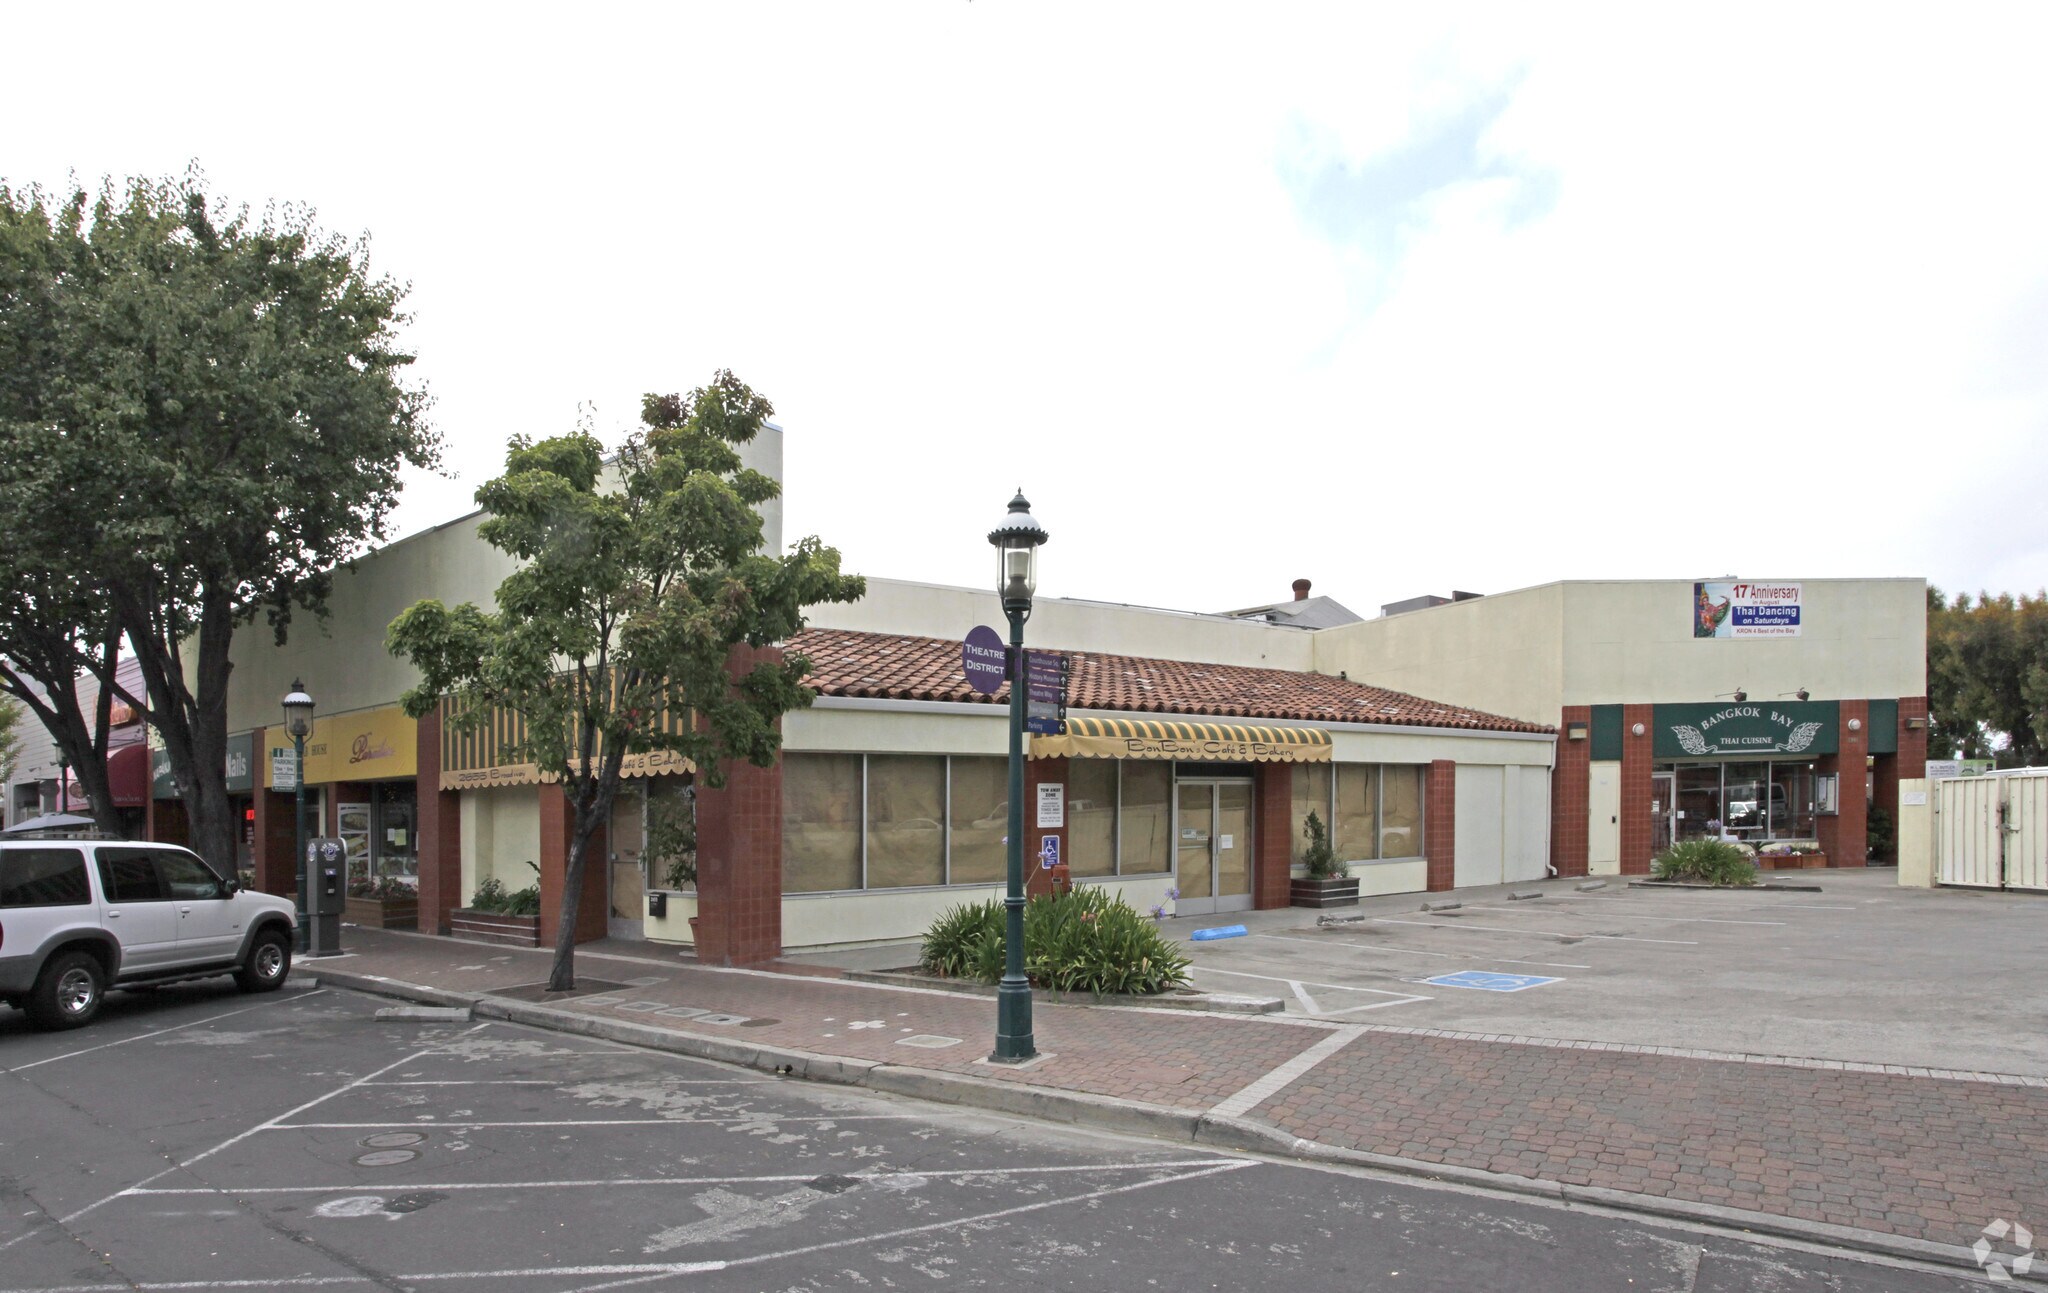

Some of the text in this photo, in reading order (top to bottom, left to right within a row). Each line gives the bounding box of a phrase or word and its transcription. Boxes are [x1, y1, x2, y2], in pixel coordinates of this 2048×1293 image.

[1733, 584, 1799, 602] 17 Anniversary
[1736, 607, 1796, 617] Thai Dancing
[965, 644, 1005, 660] THEATRE
[966, 660, 1005, 674] DISTRICT
[1029, 673, 1059, 682] History Museum
[1701, 707, 1794, 730] BANGKOK BAY
[1028, 722, 1042, 731] Parking
[1204, 741, 1236, 754] Café
[1239, 744, 1246, 754] &
[1251, 743, 1294, 758] Bakery
[226, 752, 246, 778] Nails
[620, 760, 635, 769] afé
[459, 769, 526, 781] 2655 Broadway
